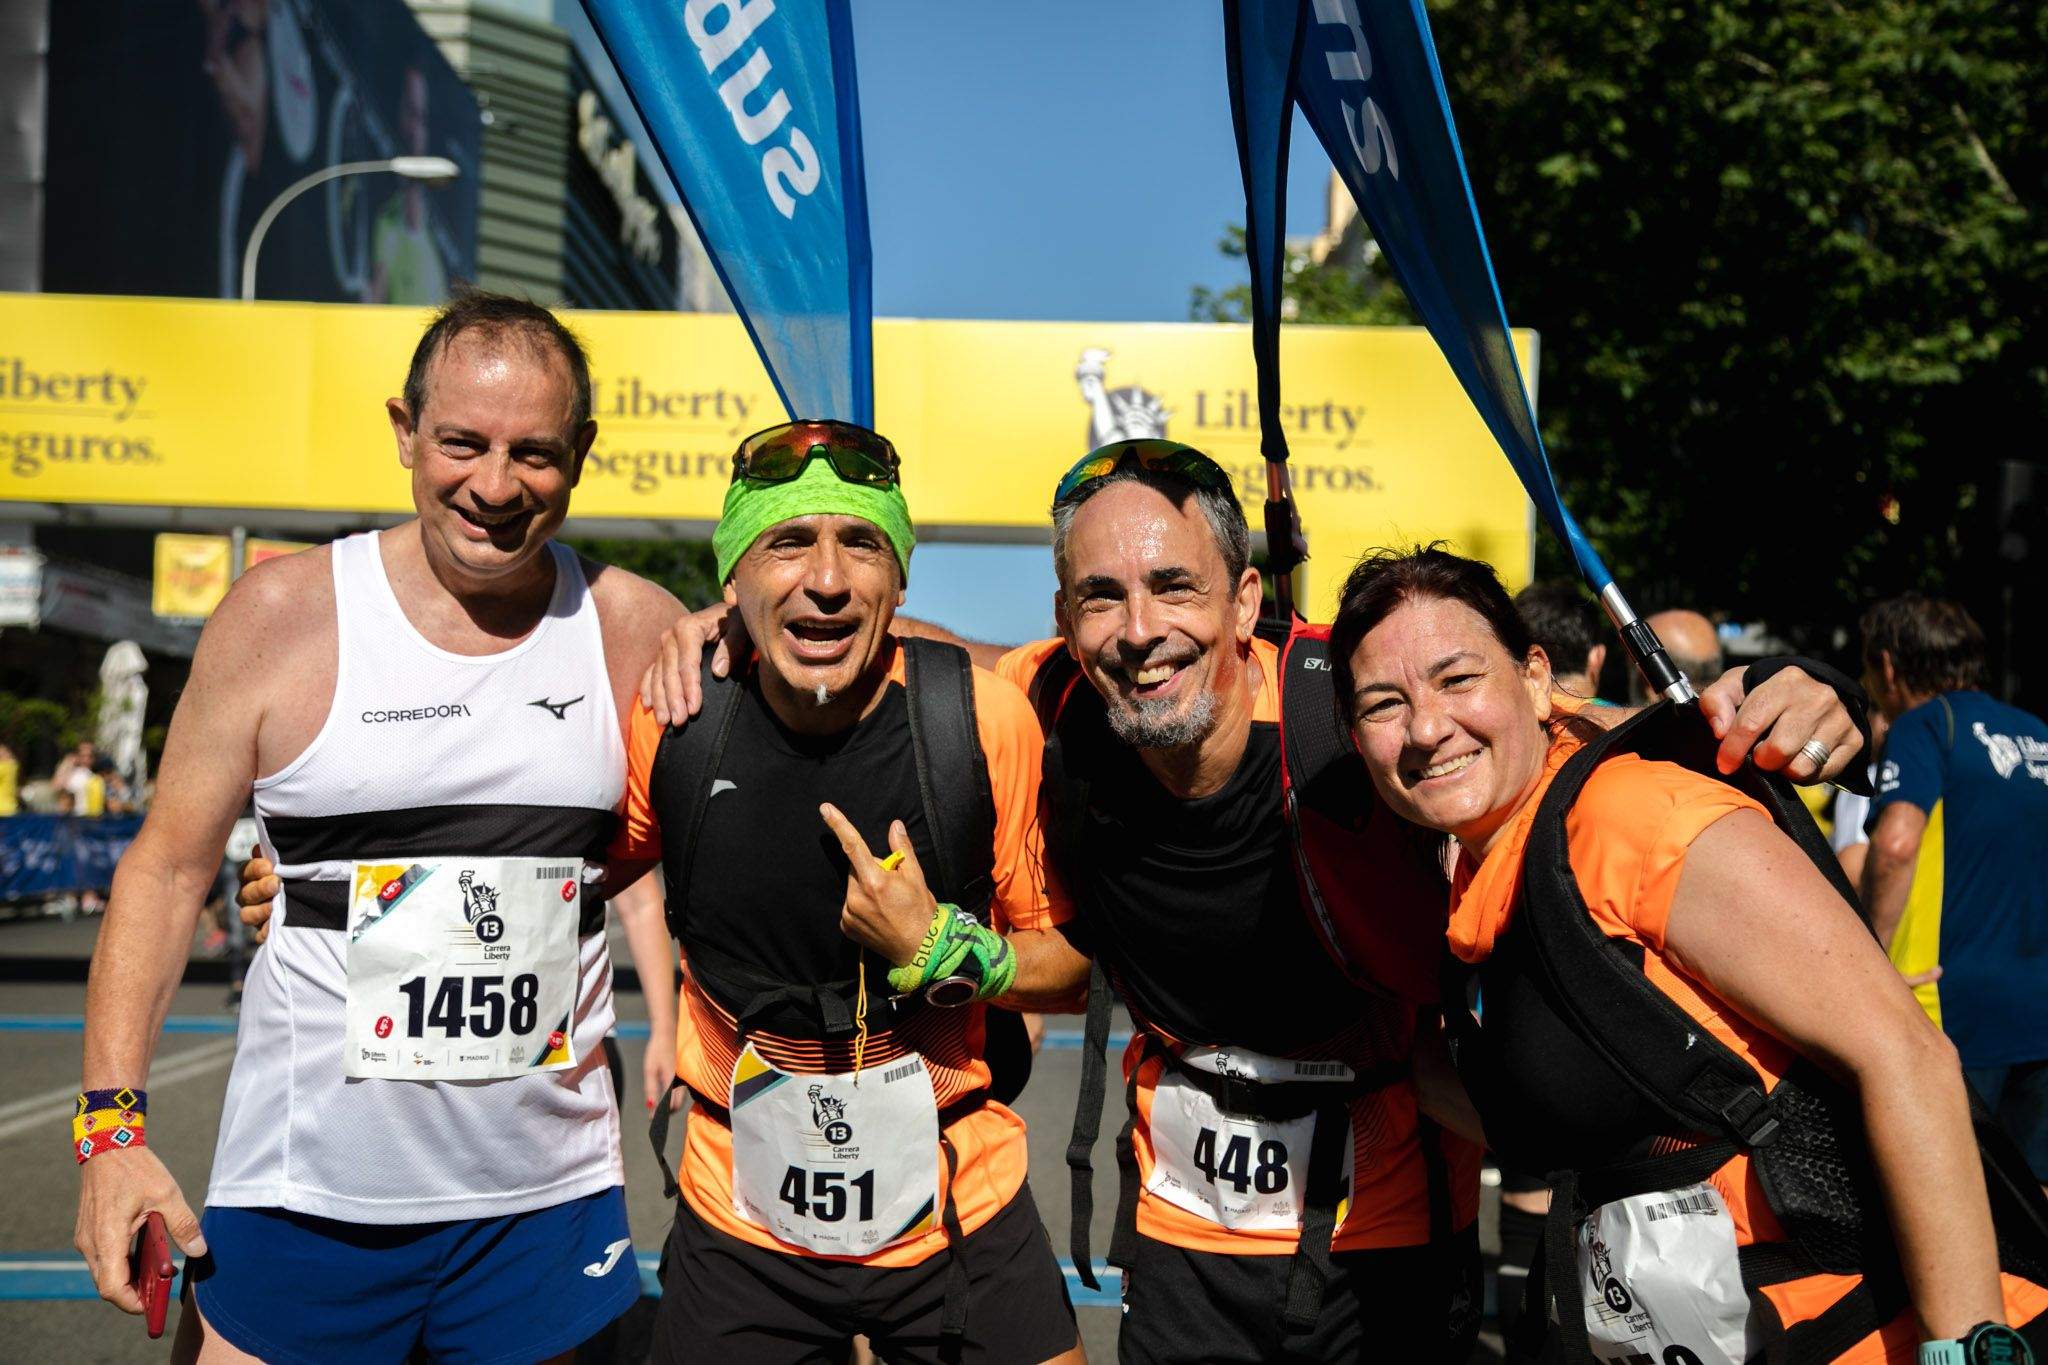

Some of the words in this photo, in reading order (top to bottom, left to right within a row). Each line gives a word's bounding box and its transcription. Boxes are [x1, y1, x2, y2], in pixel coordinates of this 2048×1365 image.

[481, 921, 500, 937] 13
[484, 952, 511, 961] Liberty
[399, 973, 540, 1038] 1458
[829, 1127, 848, 1140] 13
[1193, 1127, 1289, 1195] 448
[779, 1165, 875, 1222] 451
[1607, 1286, 1626, 1306] 13
